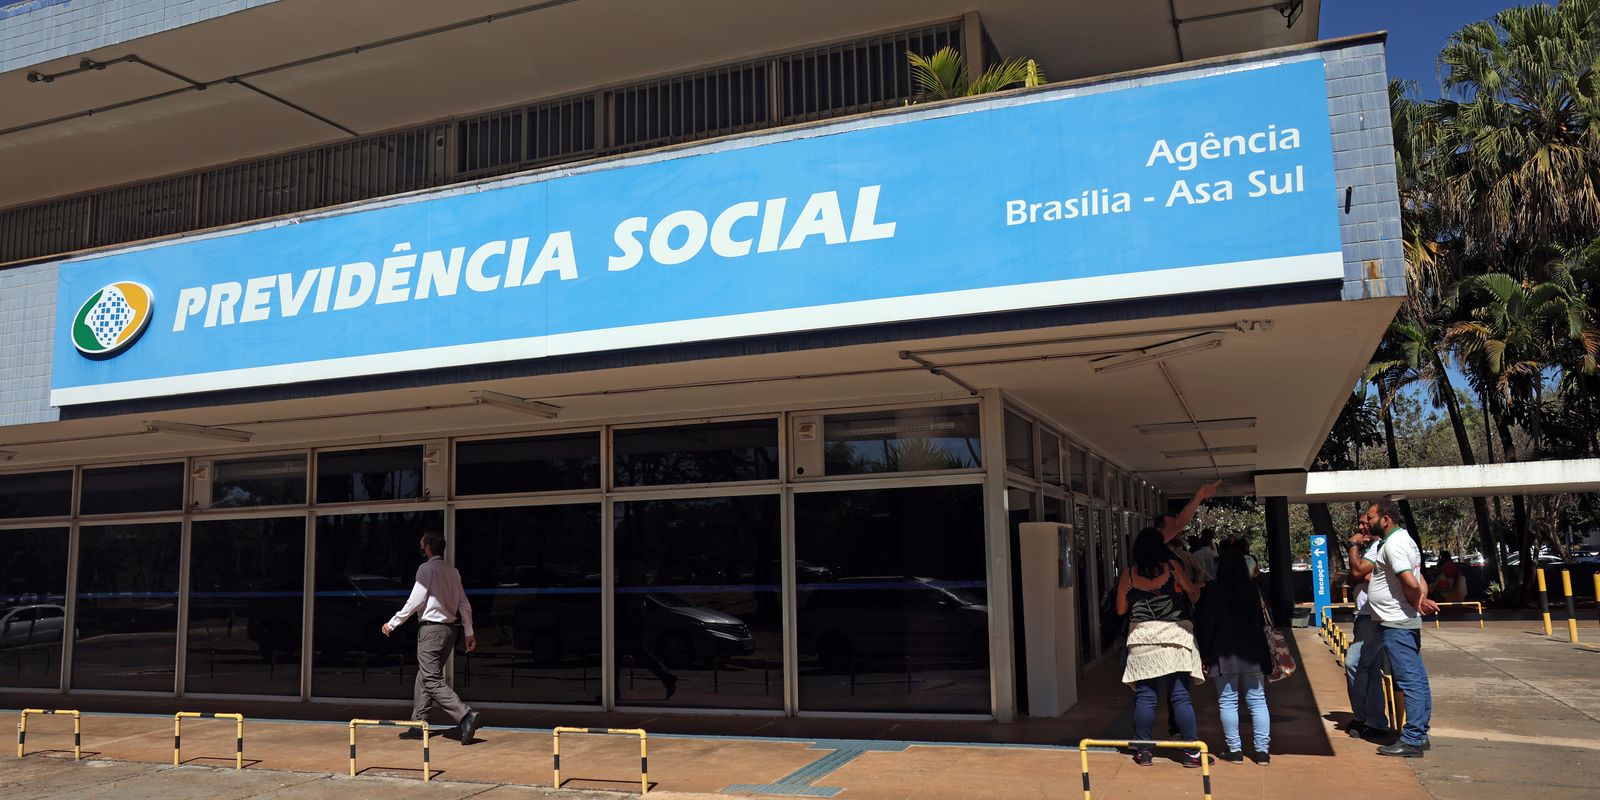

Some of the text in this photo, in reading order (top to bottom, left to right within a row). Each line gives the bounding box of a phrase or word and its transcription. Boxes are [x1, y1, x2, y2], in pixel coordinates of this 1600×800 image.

[1145, 124, 1301, 171] Agência
[1006, 187, 1132, 226] Brasília
[1165, 179, 1234, 208] Asa
[1248, 164, 1305, 198] Sul
[172, 184, 897, 333] PREVIDÊNCIA SOCIAL
[1317, 560, 1325, 596] Recepção
